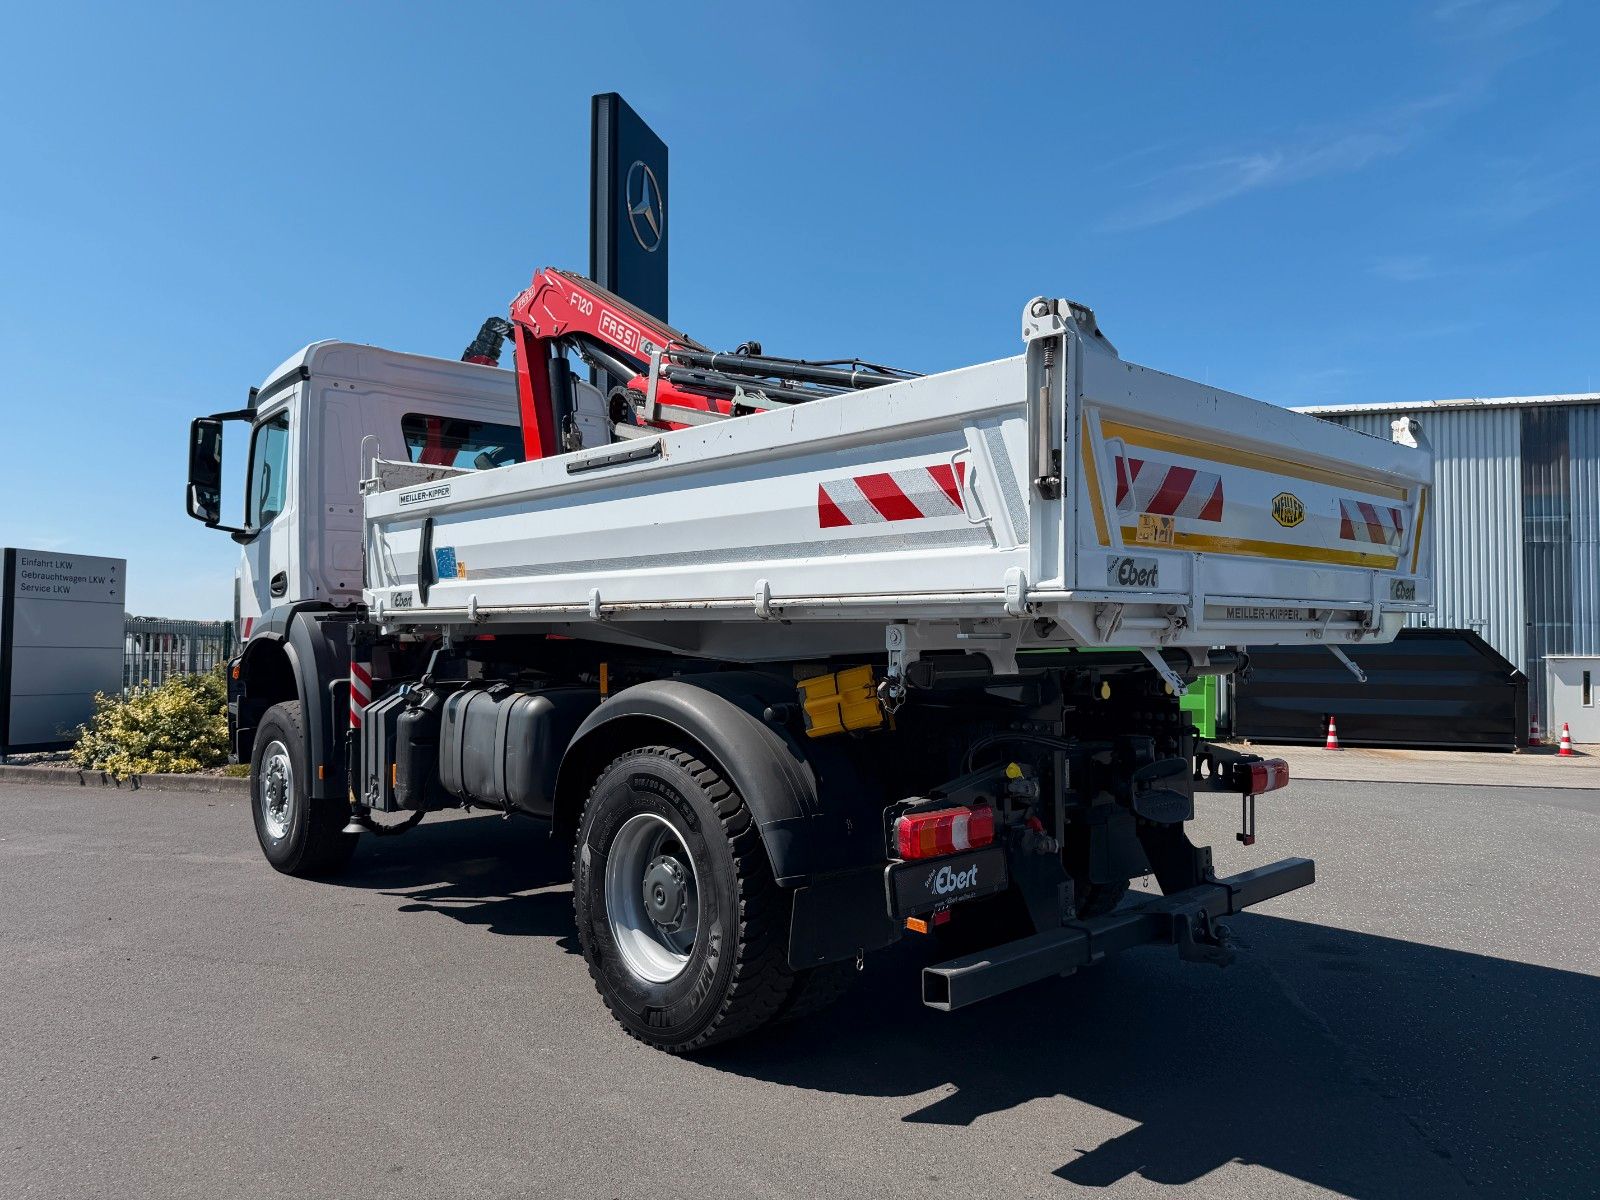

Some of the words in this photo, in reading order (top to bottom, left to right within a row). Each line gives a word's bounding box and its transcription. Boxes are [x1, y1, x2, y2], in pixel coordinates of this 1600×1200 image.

[570, 292, 593, 316] F120
[602, 316, 636, 348] FASSI
[400, 487, 450, 503] MEILLER-KIPPER
[1274, 496, 1304, 523] MEILLER
[21, 557, 53, 568] Einfahrt
[55, 560, 73, 570] LKW
[1118, 558, 1158, 587] Ebert
[21, 570, 87, 584] Gebrauchtwagen
[88, 576, 106, 584] LKW
[20, 582, 51, 592] Service
[53, 585, 71, 594] LKW
[1226, 607, 1299, 621] MEILLER-KIPPER
[936, 863, 978, 895] Ebert
